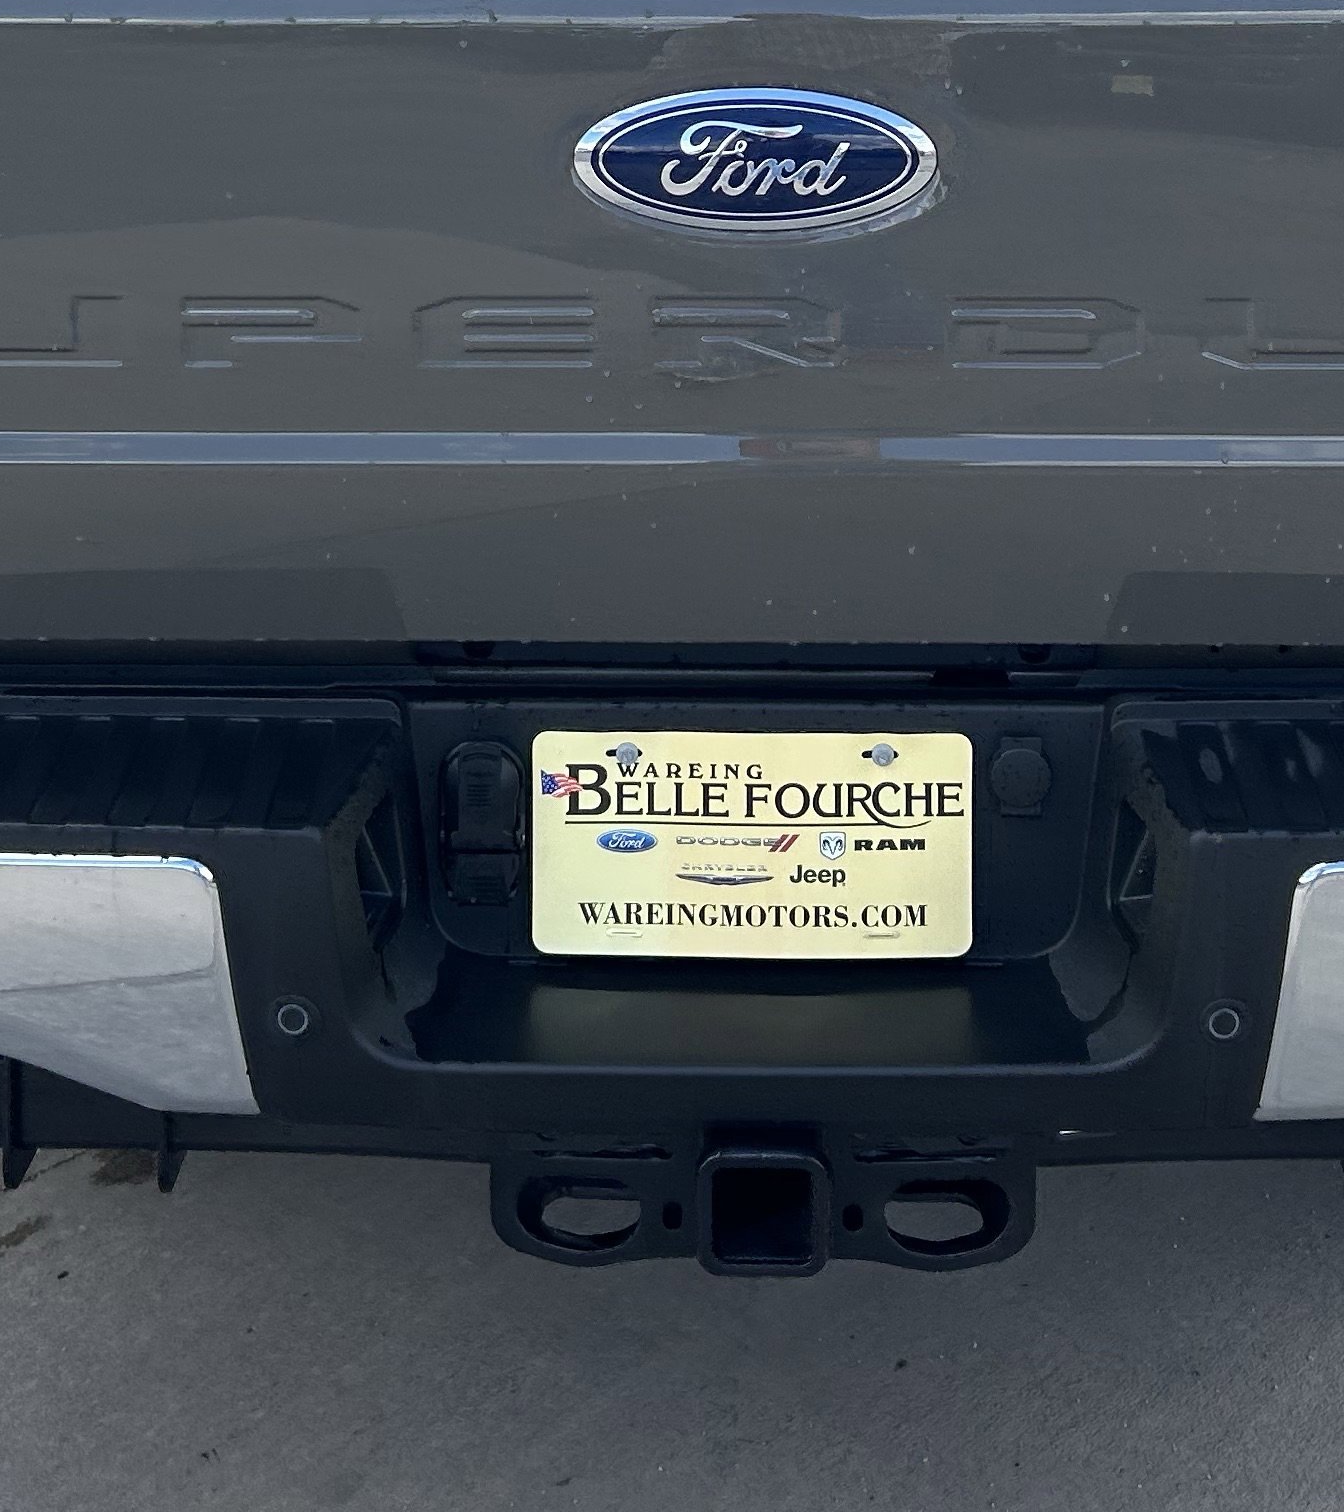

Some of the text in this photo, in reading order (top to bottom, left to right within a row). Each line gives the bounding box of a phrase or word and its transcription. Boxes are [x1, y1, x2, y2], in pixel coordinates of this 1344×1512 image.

[660, 120, 847, 197] Ford
[617, 762, 763, 780] WAREING
[565, 763, 965, 828] BELLE FOURCHE
[609, 831, 646, 849] Ford
[676, 835, 778, 847] DODGE
[854, 838, 926, 852] RAM
[789, 864, 846, 887] Jeep
[578, 901, 928, 928] WAREINGMOTORS.COM
